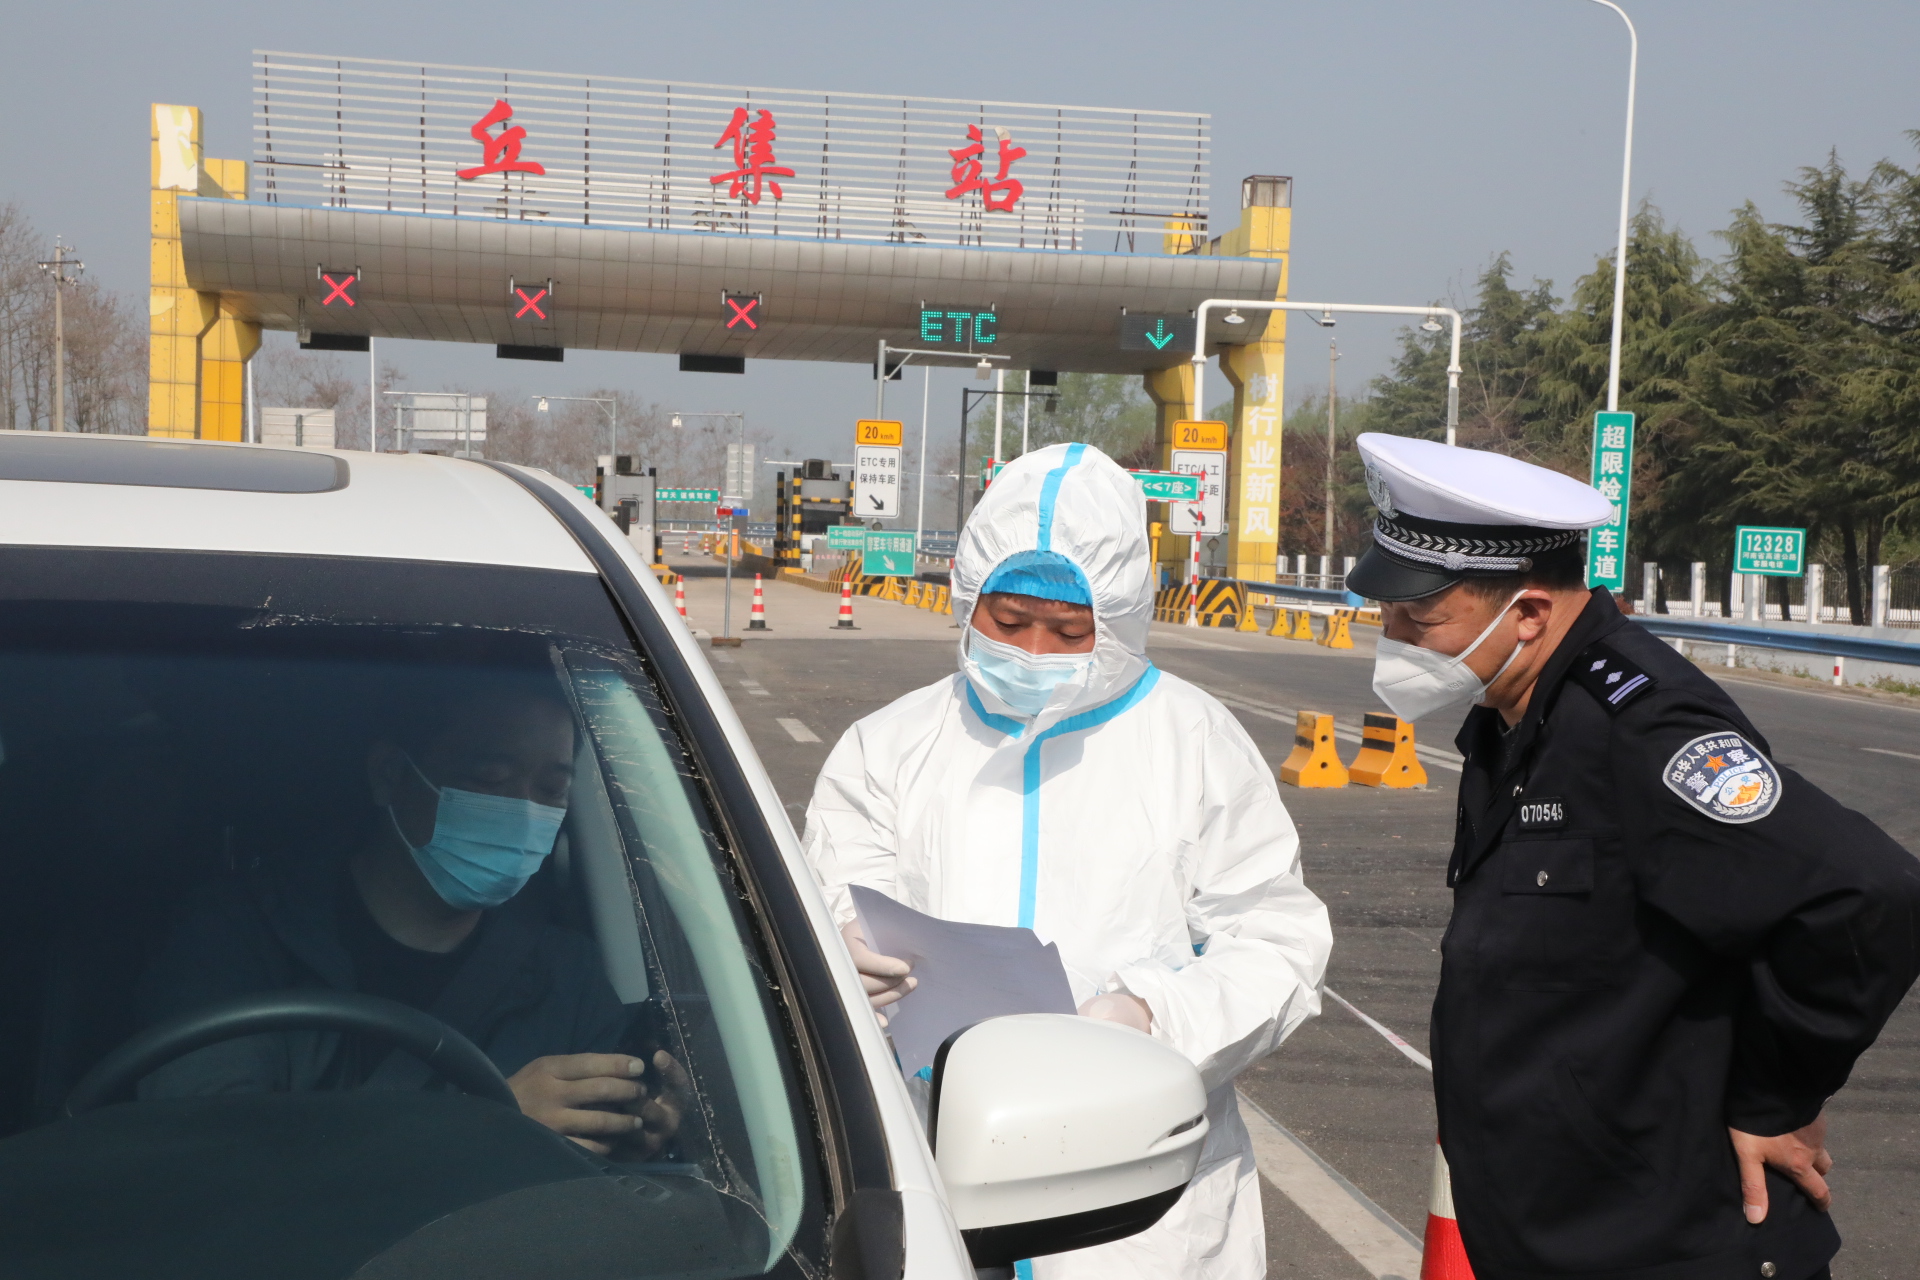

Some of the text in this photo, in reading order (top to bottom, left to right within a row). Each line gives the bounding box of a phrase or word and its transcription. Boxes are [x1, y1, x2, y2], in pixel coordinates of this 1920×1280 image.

[456, 97, 1027, 212] 丘集站
[921, 311, 996, 343] ETC
[865, 426, 878, 439] 20
[1183, 428, 1218, 444] 20 km/h
[860, 457, 896, 468] ETC专用
[1244, 372, 1279, 537] 树行业新风
[860, 473, 896, 485] 保持车距
[1746, 534, 1794, 553] 12328
[1743, 551, 1797, 561] 河南省高速公路
[1753, 560, 1784, 569] 客服电话
[1671, 738, 1743, 783] 中华人民共和国
[1713, 765, 1745, 788] POLICE
[1521, 803, 1562, 823] 070545
